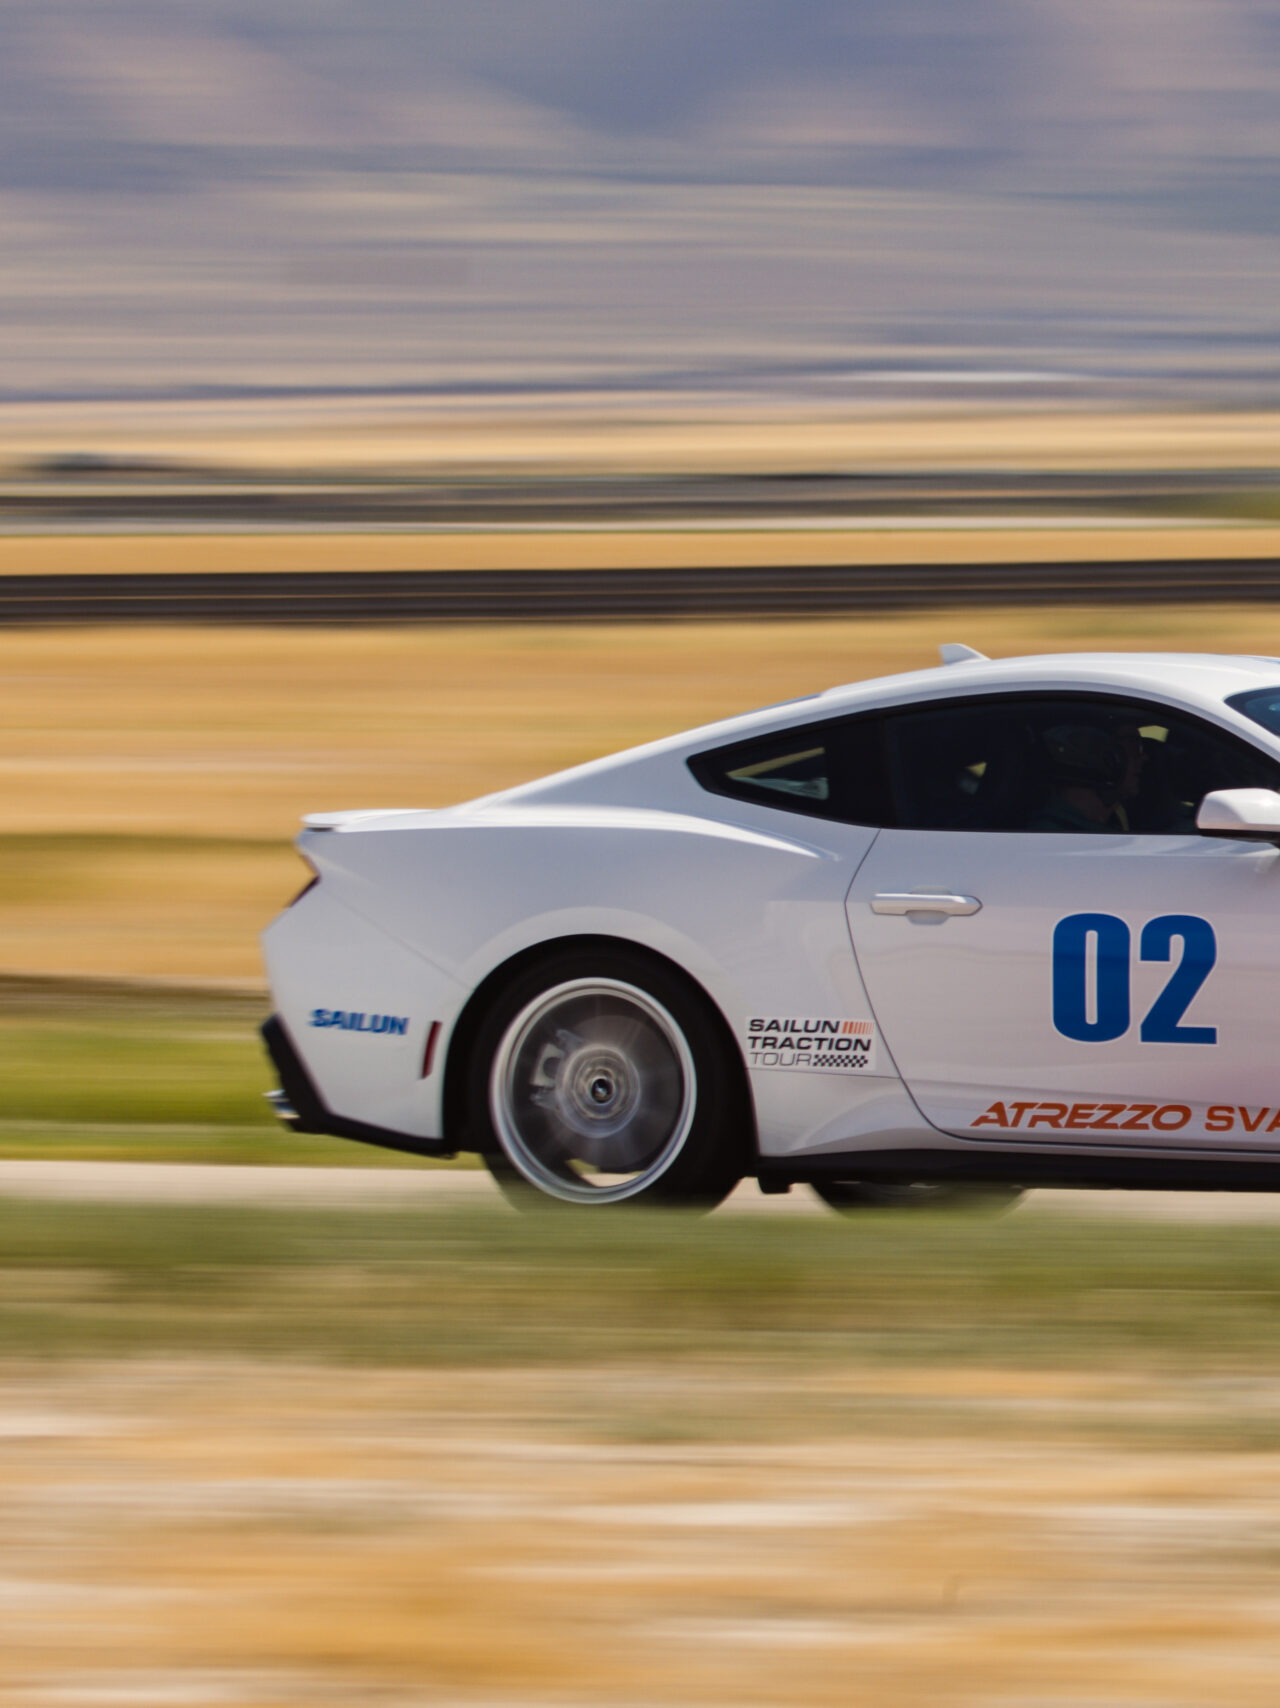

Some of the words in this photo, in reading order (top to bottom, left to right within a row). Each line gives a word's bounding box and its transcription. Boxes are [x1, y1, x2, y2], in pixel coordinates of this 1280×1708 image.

[1053, 913, 1217, 1044] 02
[310, 1008, 410, 1035] SAILUN
[749, 1019, 840, 1033] SAILUN
[747, 1036, 871, 1051] TRACTION
[749, 1052, 812, 1066] TOUR
[970, 1101, 1192, 1131] ATREZZO
